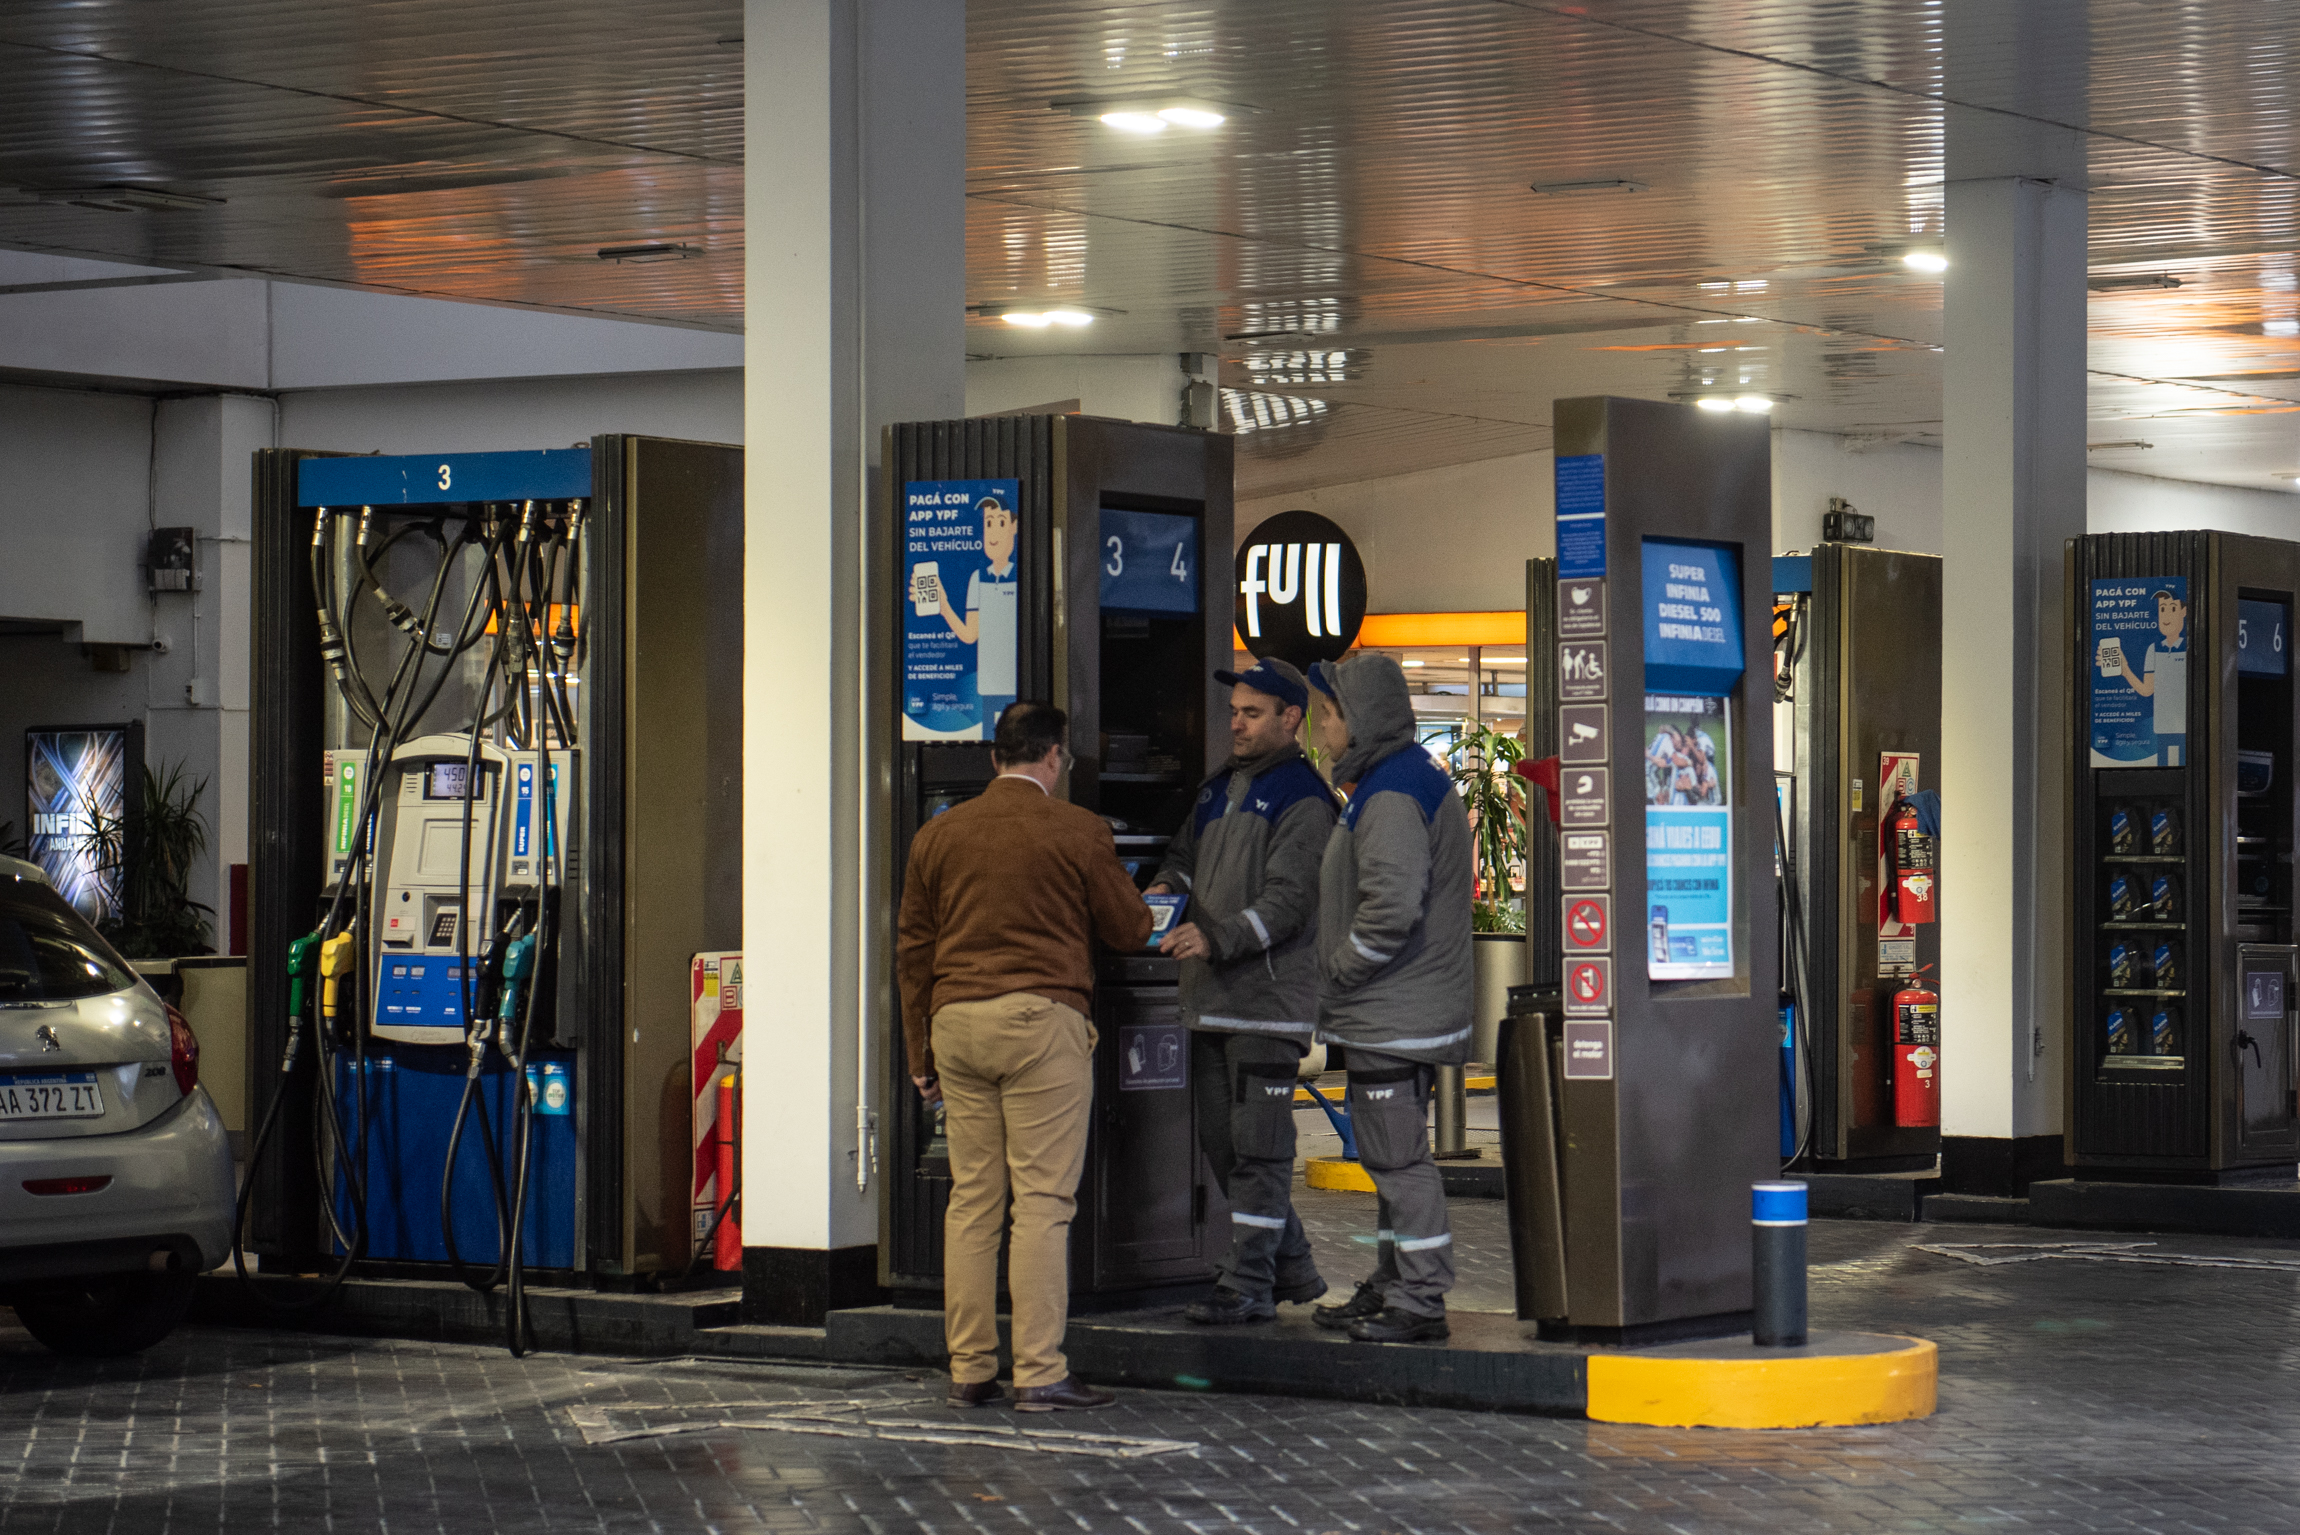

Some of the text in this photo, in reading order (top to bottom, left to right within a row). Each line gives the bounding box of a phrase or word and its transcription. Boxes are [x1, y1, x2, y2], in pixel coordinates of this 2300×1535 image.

[438, 464, 451, 490] 3
[909, 492, 969, 506] PAGÁ CON
[909, 510, 958, 521] APP YPF
[909, 526, 973, 537] SIN BAJARTE
[909, 539, 983, 552] DEL VEHÍCULO
[1106, 536, 1187, 582] 3 4
[1668, 563, 1706, 582] SUPER
[1240, 543, 1341, 638] full
[1666, 582, 1710, 602] INFINIA
[2096, 586, 2146, 596] PAGÁ CON
[1658, 602, 1721, 622] DIESEL 500
[2112, 611, 2150, 619] BAJARTE
[2114, 621, 2157, 630] VEHÍCULO
[2238, 620, 2282, 652] 5 6
[1883, 756, 1889, 765] 39
[518, 826, 526, 852] SUPER
[1925, 1080, 1931, 1088] 3
[1265, 1086, 1290, 1096] YPF
[1366, 1089, 1394, 1100] YPF
[26, 1086, 67, 1112] 372
[70, 1086, 95, 1110] ZT
